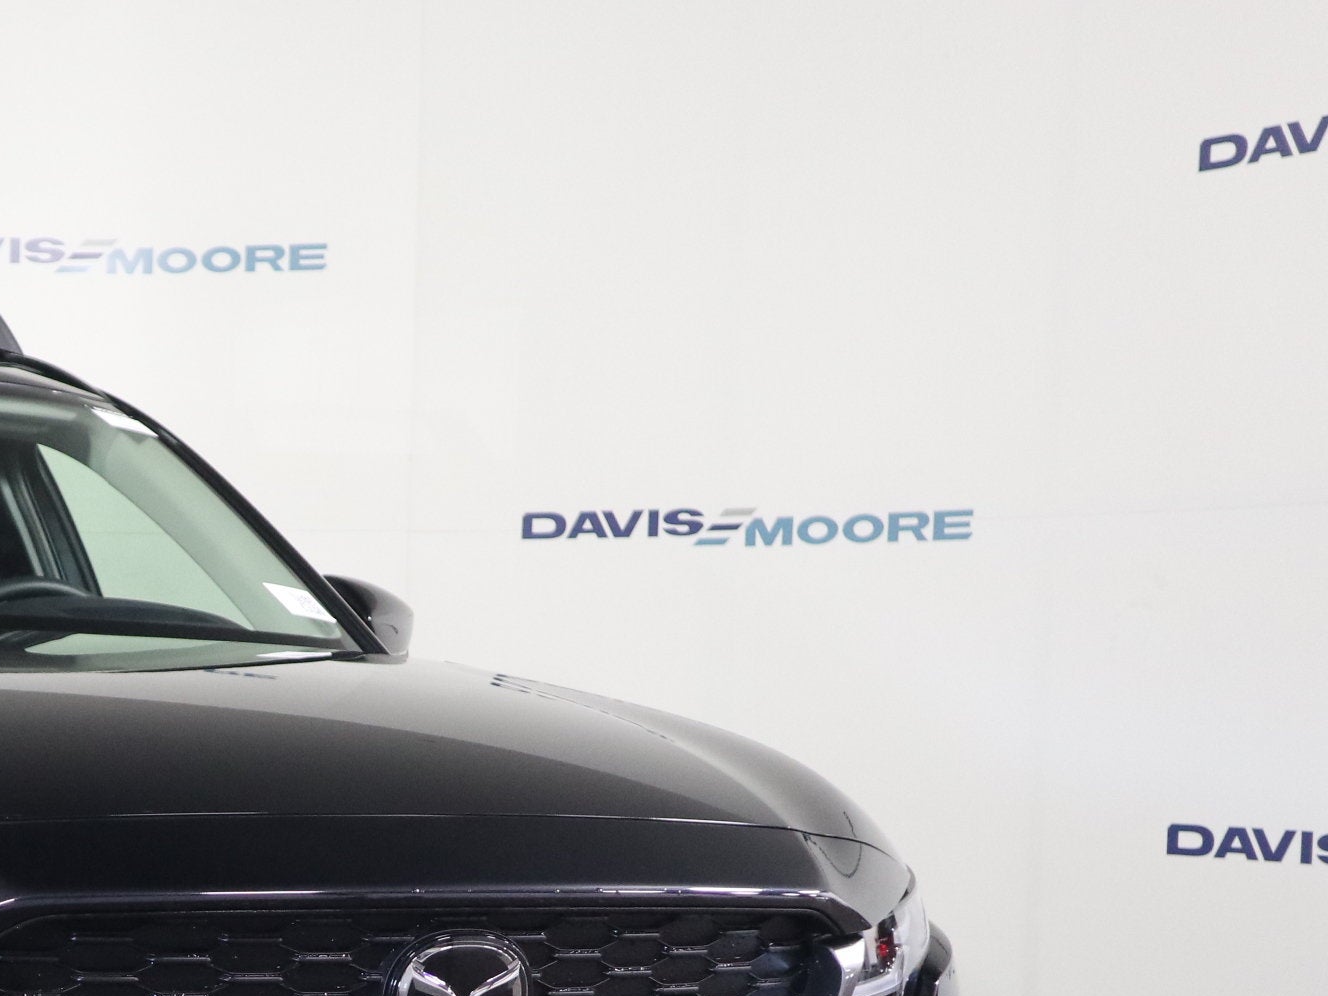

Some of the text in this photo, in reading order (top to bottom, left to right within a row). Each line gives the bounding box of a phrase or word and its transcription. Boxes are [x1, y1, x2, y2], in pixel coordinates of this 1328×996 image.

[1198, 115, 1328, 174] DAV
[107, 243, 328, 275] MOORE
[521, 508, 974, 548] DAVIS MOORE
[1166, 823, 1328, 866] DAVI
